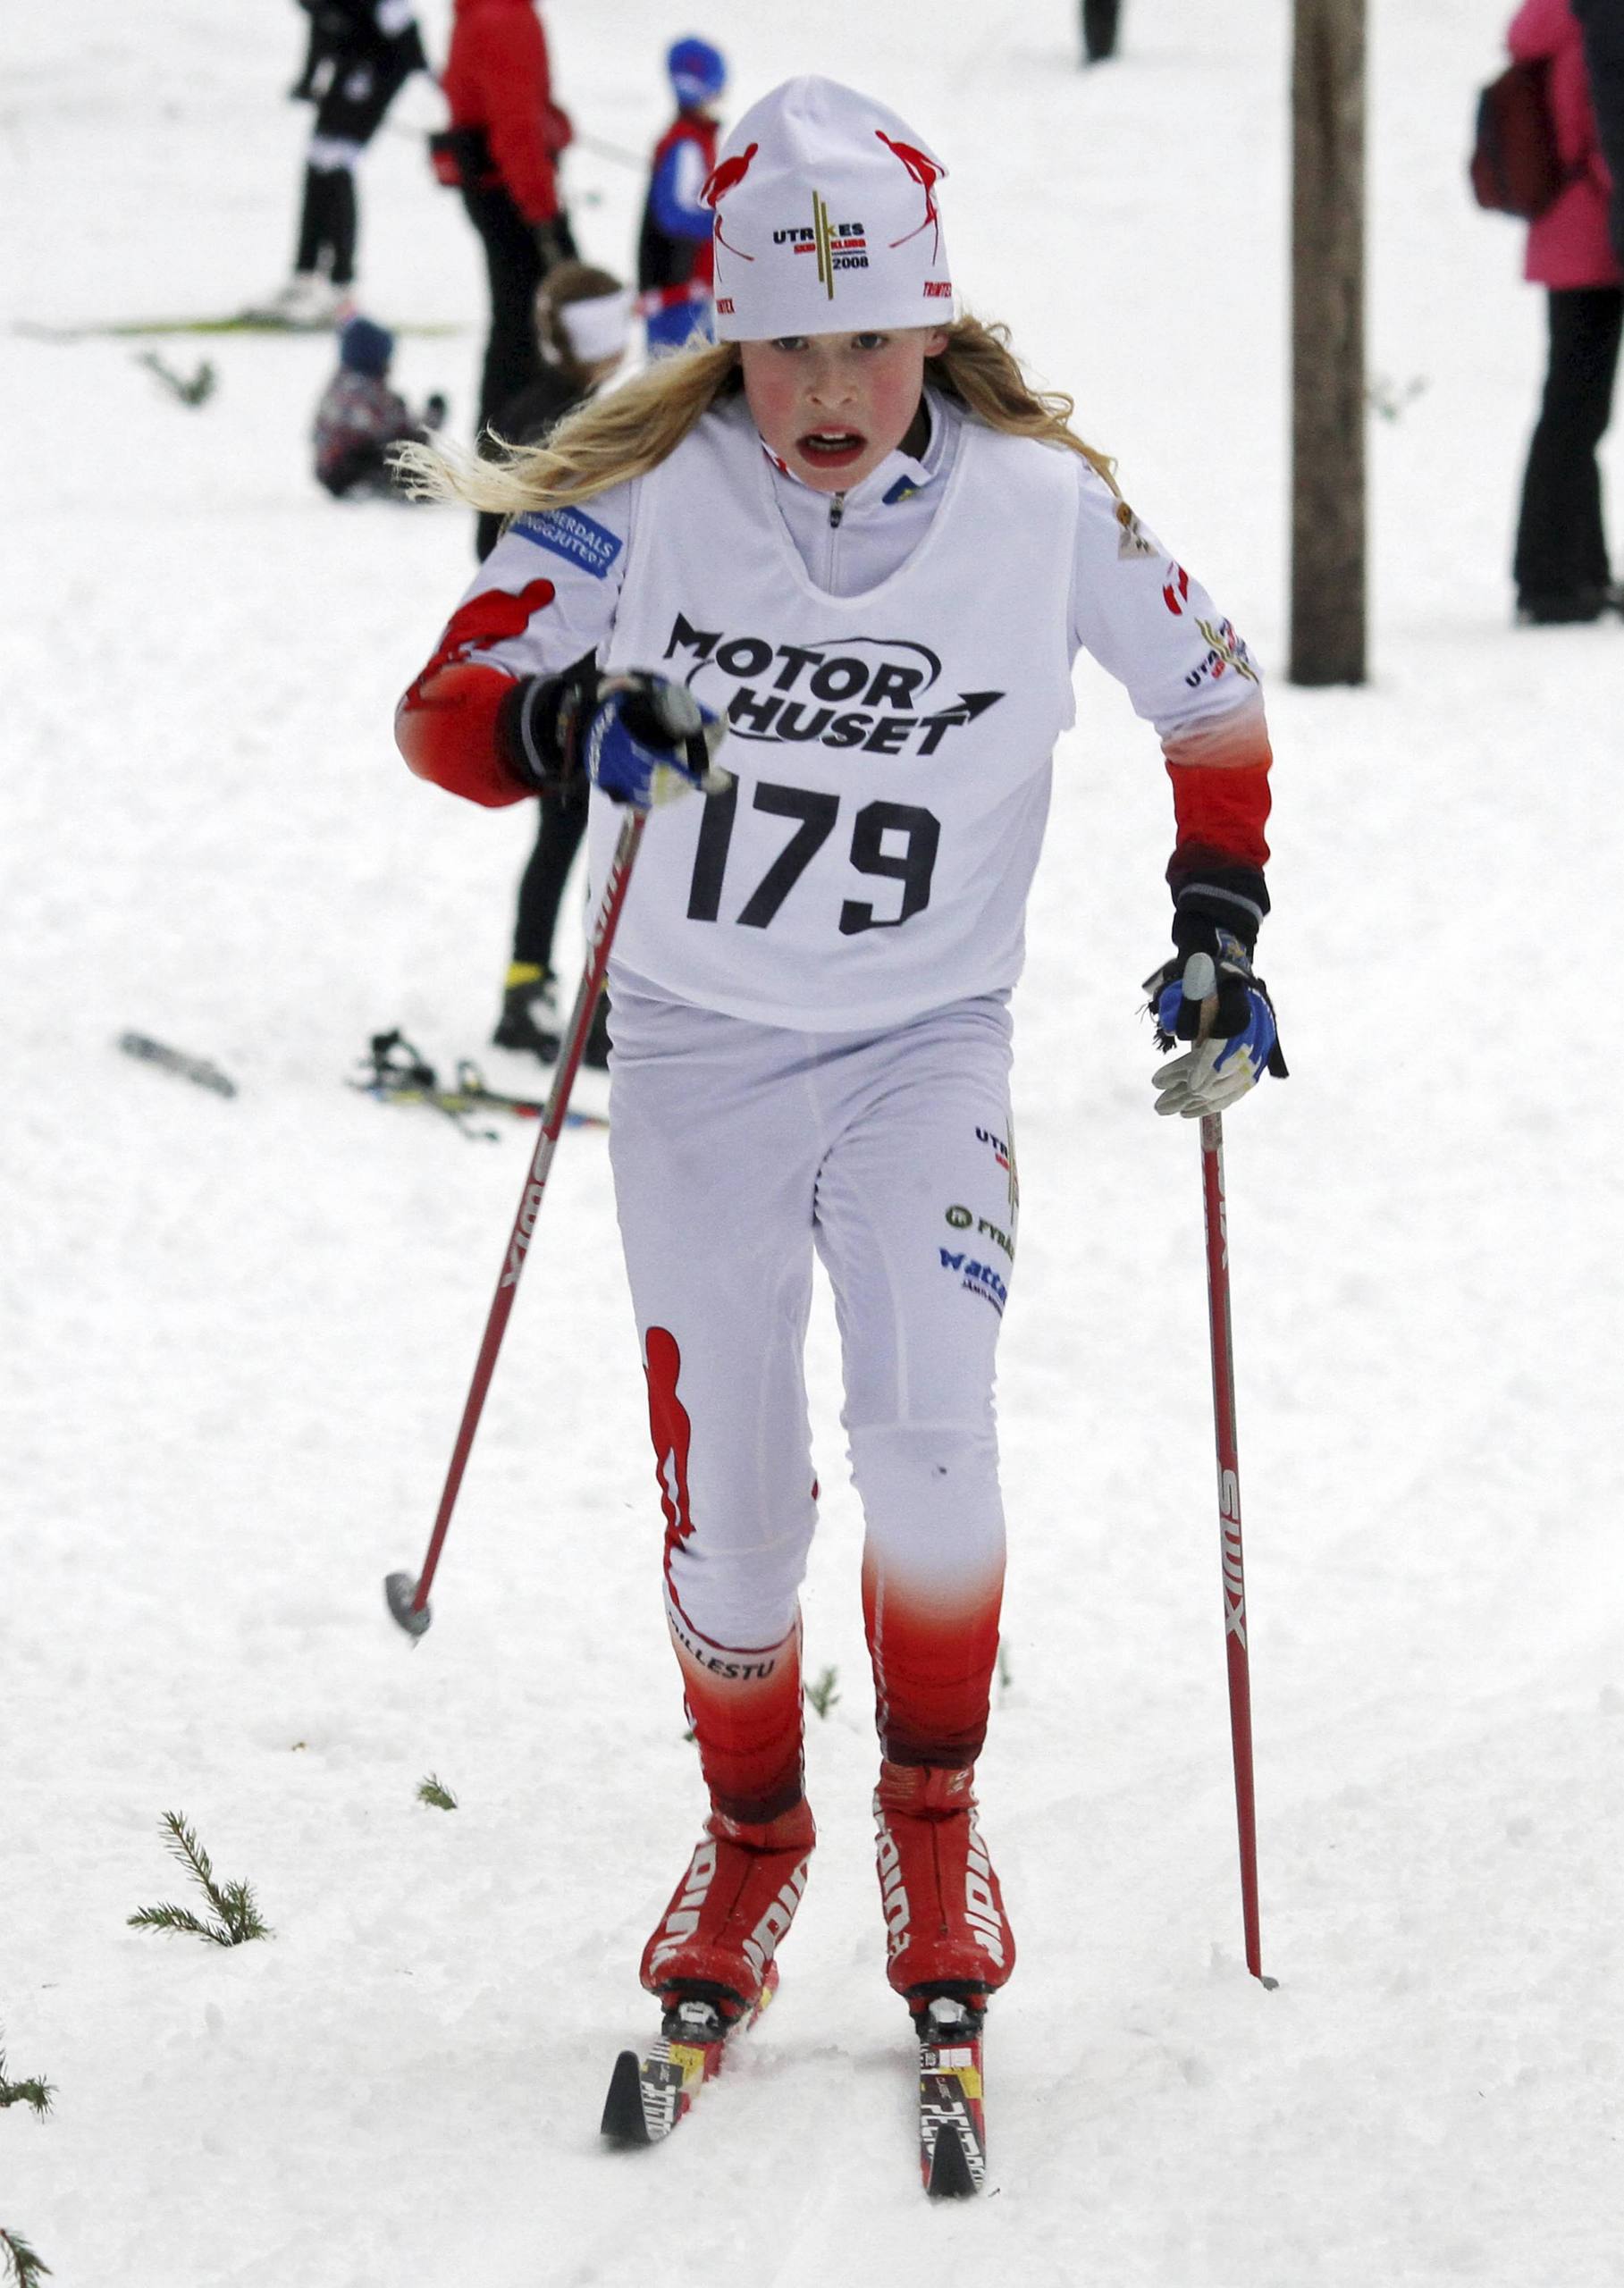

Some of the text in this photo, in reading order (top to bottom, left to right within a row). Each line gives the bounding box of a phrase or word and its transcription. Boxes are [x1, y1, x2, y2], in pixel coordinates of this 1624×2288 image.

[831, 256, 870, 270] 2008
[663, 611, 924, 711] MOTOR
[727, 686, 968, 756] HUSET
[686, 770, 942, 936] 179
